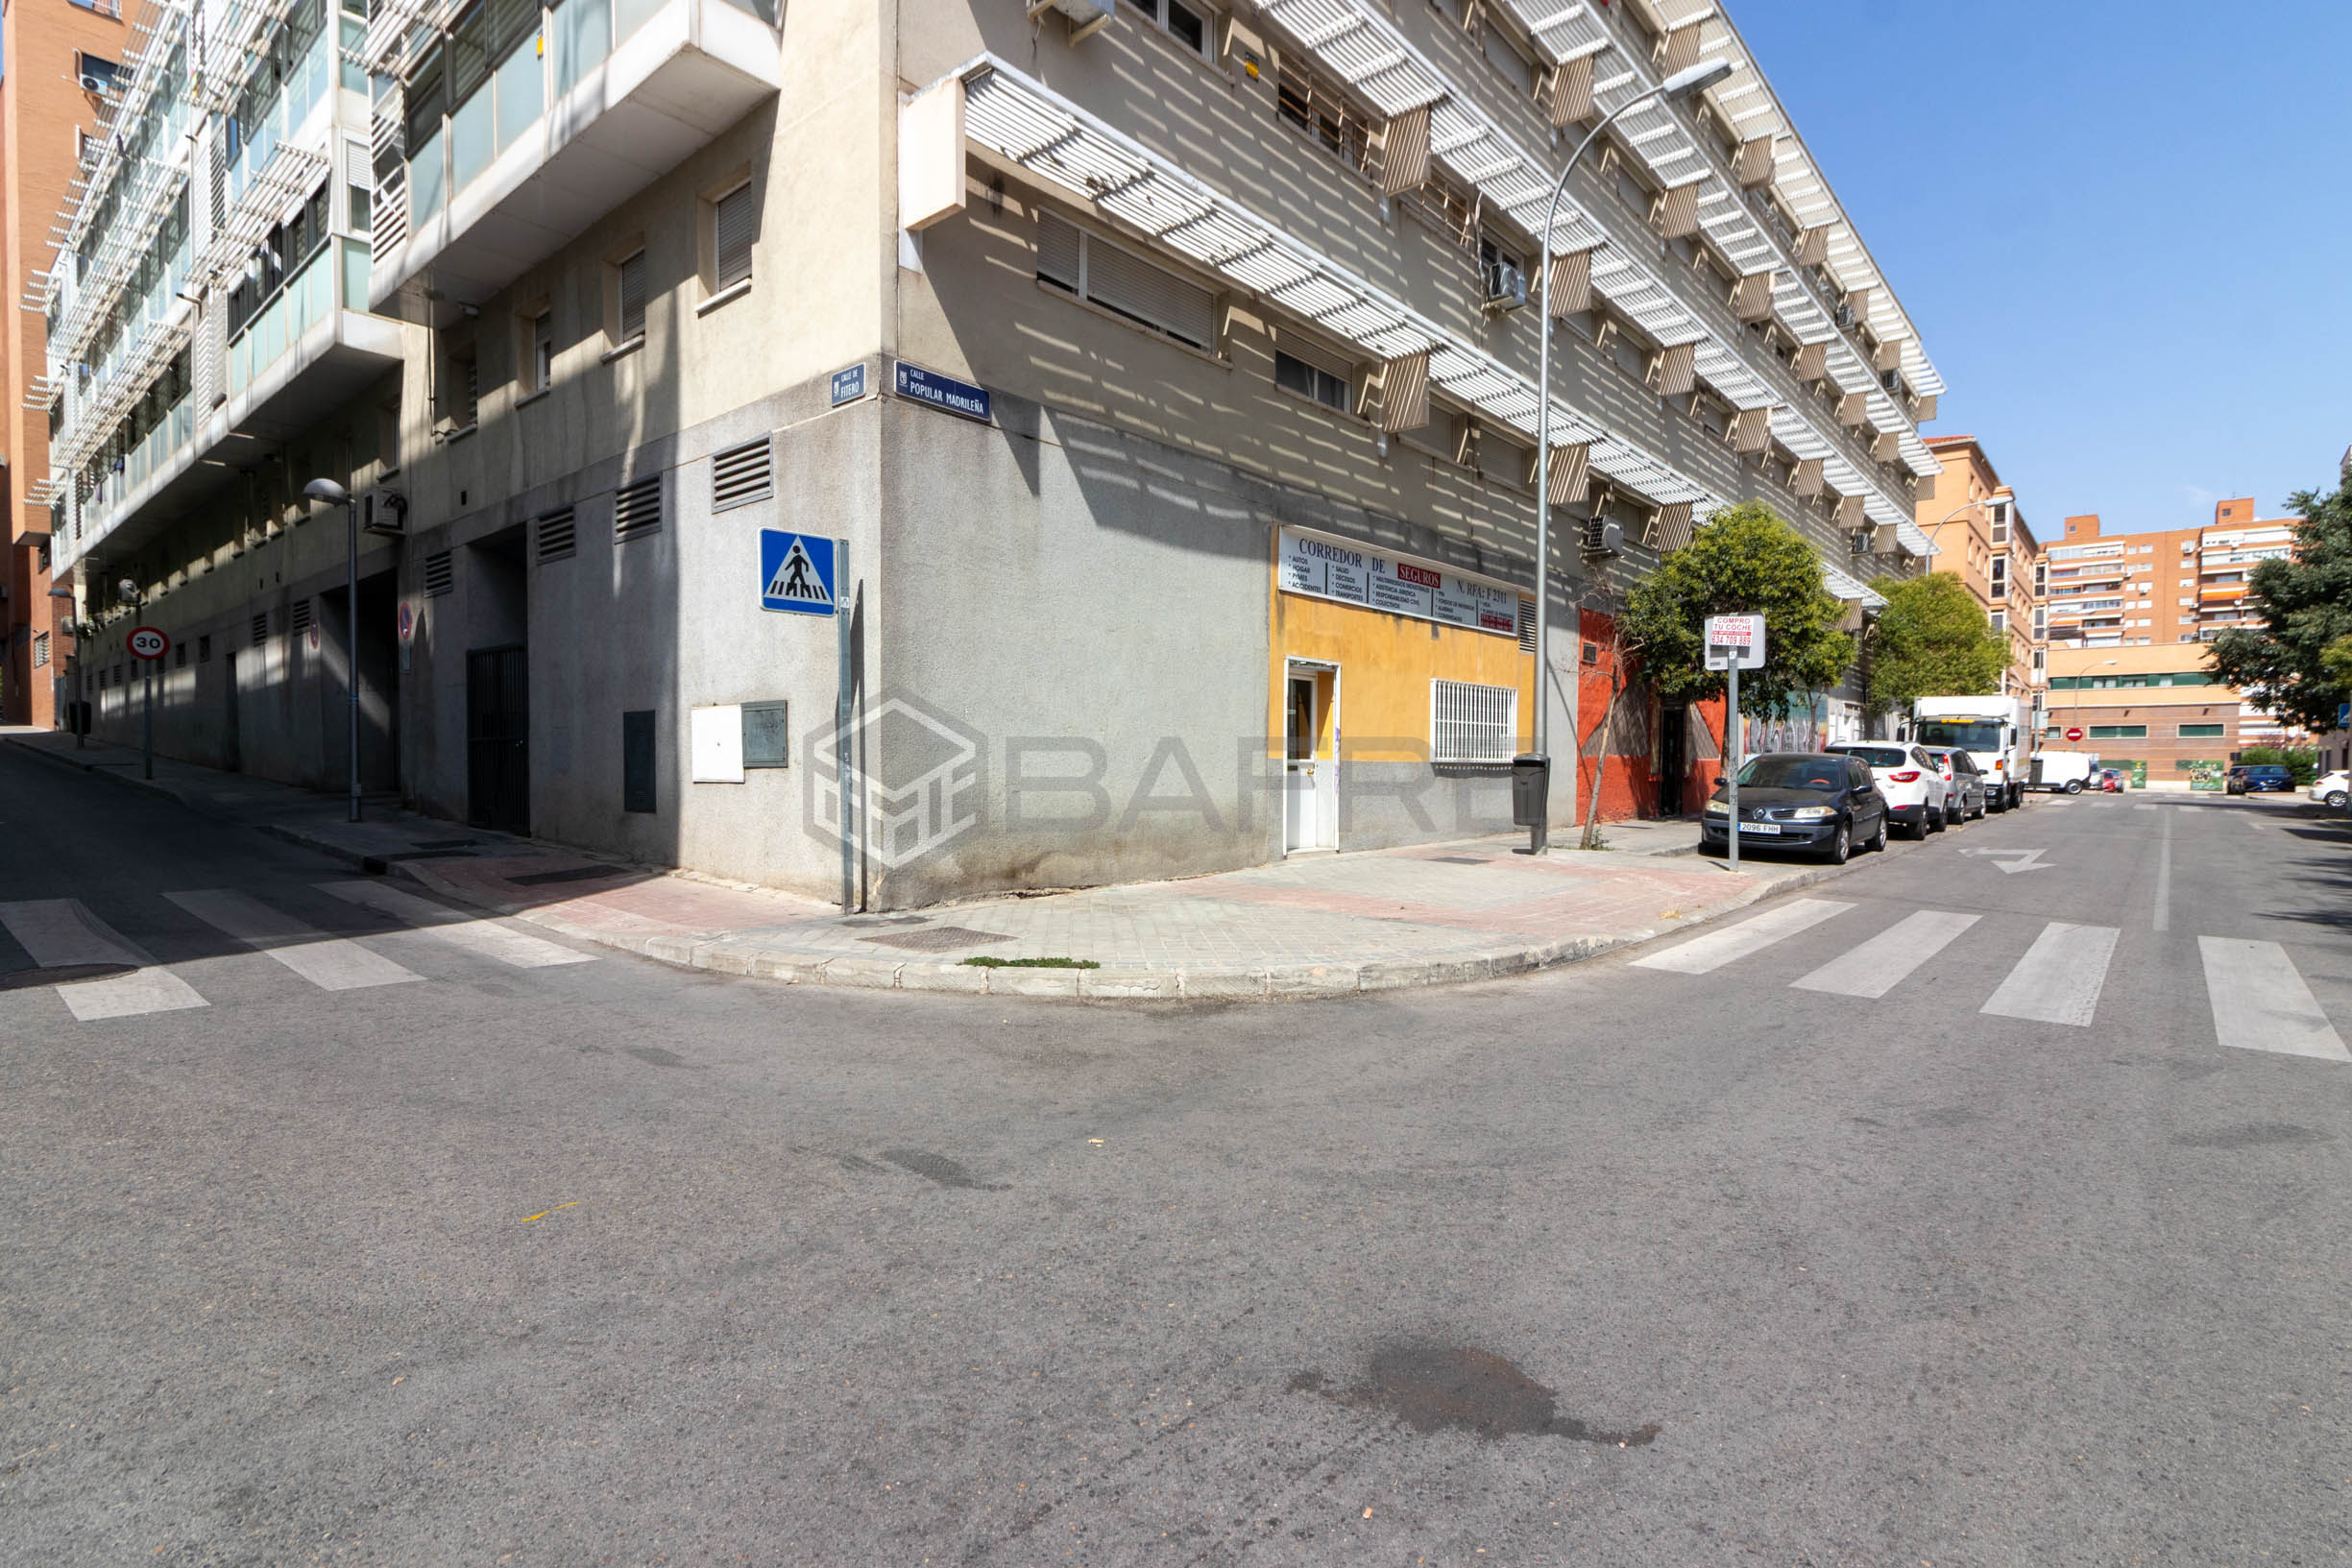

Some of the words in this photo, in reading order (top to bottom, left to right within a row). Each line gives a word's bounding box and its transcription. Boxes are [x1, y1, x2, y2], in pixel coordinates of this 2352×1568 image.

[841, 373, 852, 382] CALLE
[853, 370, 859, 378] DE
[910, 369, 924, 380] CALLE
[841, 381, 860, 398] FITERO
[910, 381, 943, 402] POPULAR
[946, 394, 983, 415] MADRILEÑA
[1293, 555, 1308, 565] AUTOS
[1298, 538, 1362, 568] CORREDOR
[1371, 557, 1385, 574] DE
[1400, 566, 1439, 586] SEGUROS
[1293, 565, 1310, 573] HOGAR
[1335, 566, 1349, 574] SALUD
[1293, 573, 1308, 582] PYMES
[1335, 574, 1356, 584] DECESOS
[1335, 582, 1362, 593] COMERCIOS
[1335, 590, 1364, 602] TRANSPORTES
[136, 638, 160, 649] 30
[1727, 636, 1736, 645] 709
